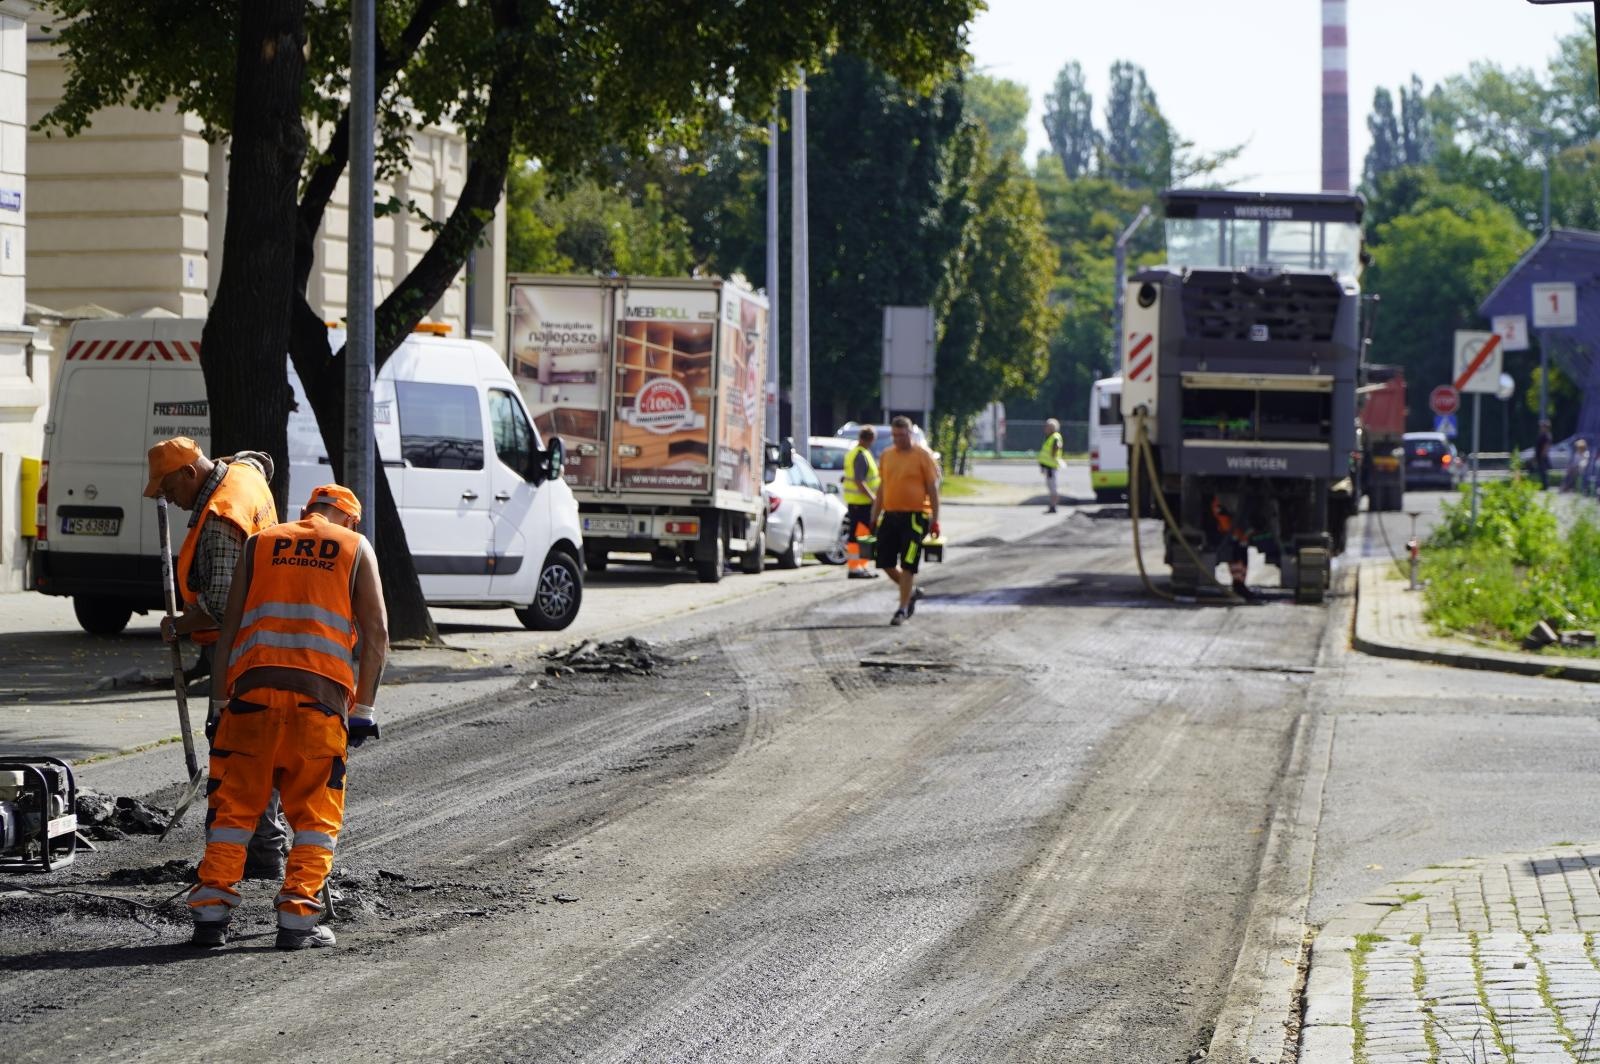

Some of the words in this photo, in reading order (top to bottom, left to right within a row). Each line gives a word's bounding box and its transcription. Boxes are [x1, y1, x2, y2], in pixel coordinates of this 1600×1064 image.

[1233, 206, 1293, 219] WIRTGEN
[1548, 292, 1559, 314] 1
[626, 306, 688, 319] MEBROLL
[528, 330, 597, 347] najlepsze
[153, 401, 208, 417] FREZDROM
[153, 425, 210, 437] WWW.FREZDRO
[1226, 456, 1288, 470] WIRTGEN
[273, 538, 340, 559] PRD
[271, 557, 336, 571] RACIBÓRZ
